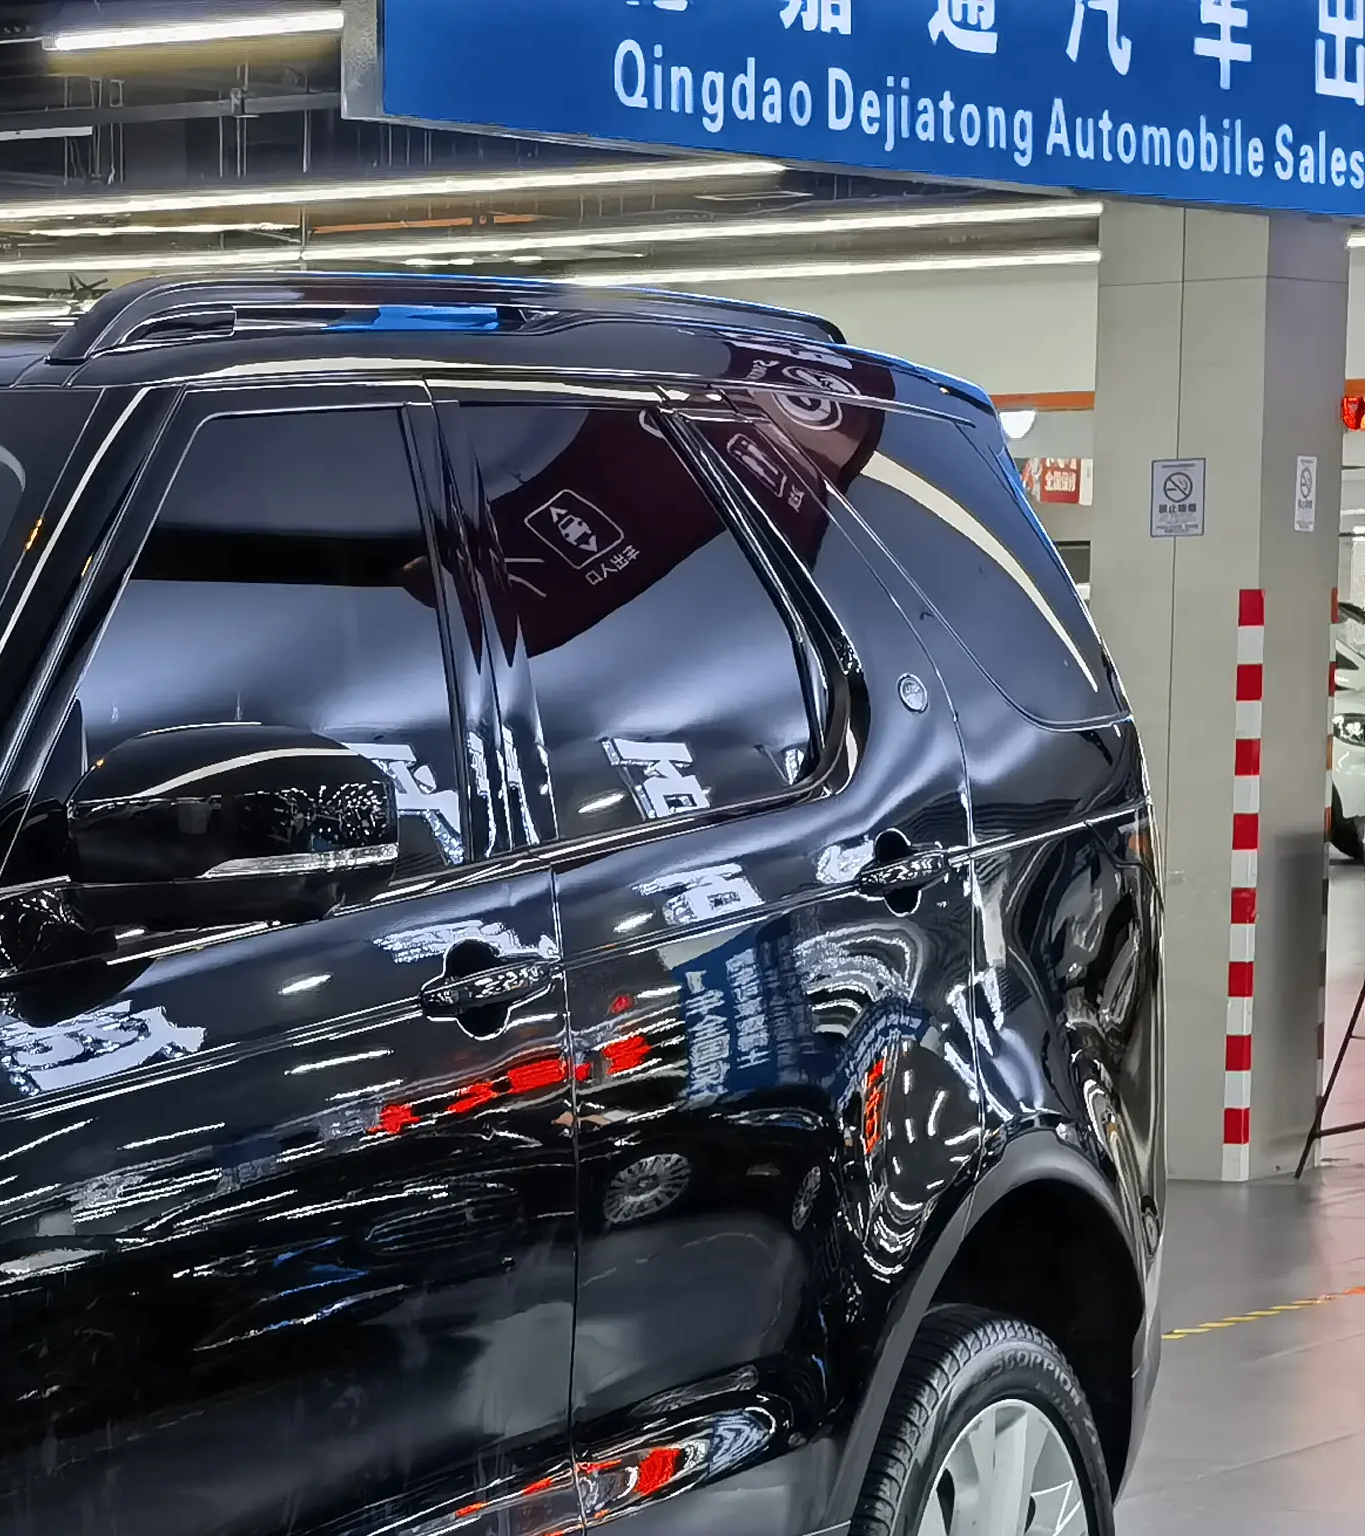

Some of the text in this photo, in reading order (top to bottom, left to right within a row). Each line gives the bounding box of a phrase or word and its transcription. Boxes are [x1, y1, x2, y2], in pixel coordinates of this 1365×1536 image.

[614, 38, 1365, 189] Qingdao Dejiatong Automobile Sales
[626, 0, 1365, 106] 汽车出
